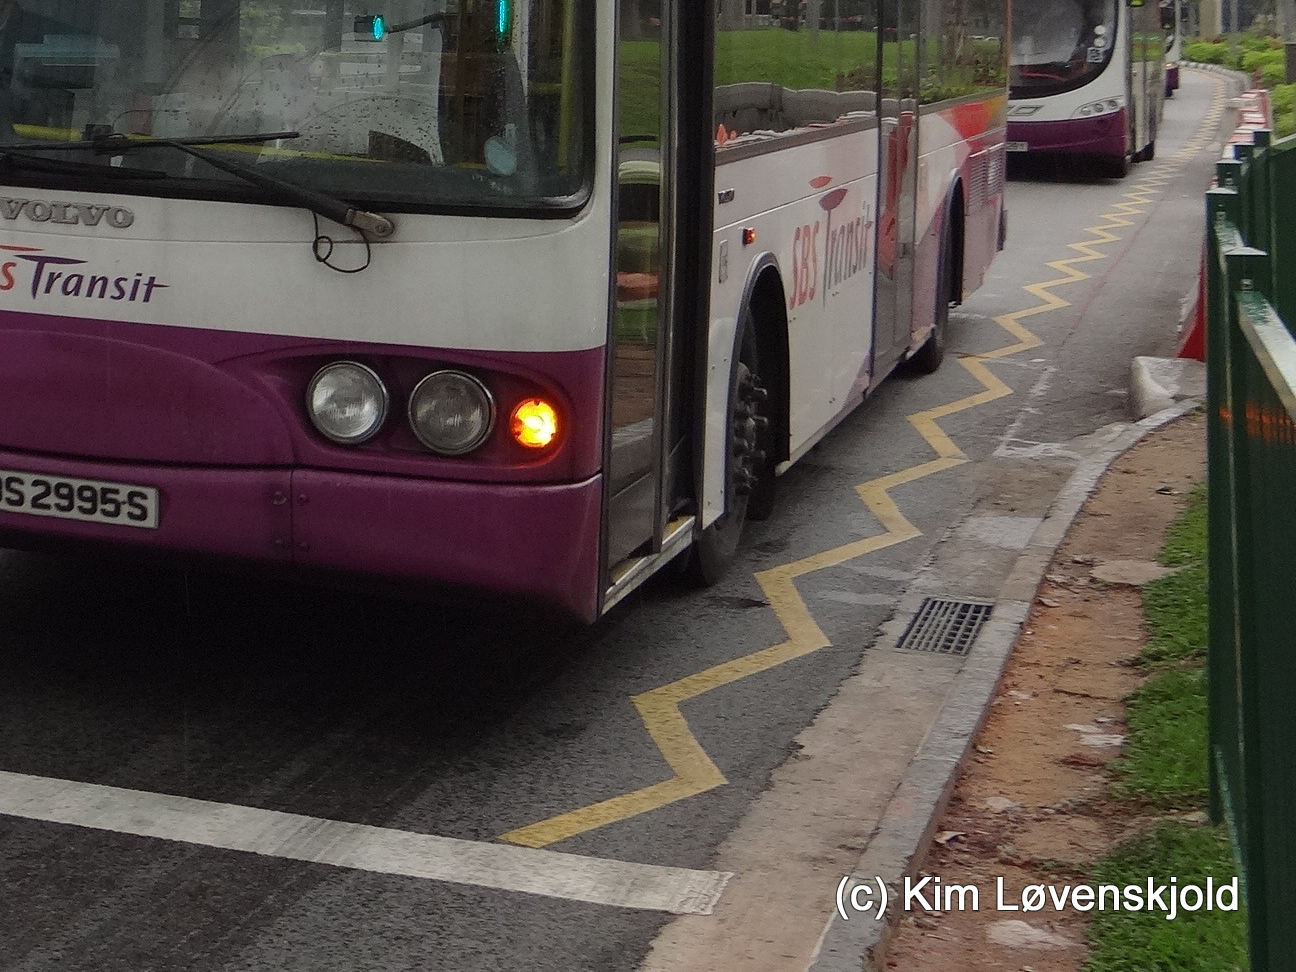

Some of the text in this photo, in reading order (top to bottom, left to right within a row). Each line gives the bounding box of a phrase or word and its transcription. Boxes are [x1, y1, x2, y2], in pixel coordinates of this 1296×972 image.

[13, 254, 171, 303] Transit
[790, 221, 820, 311] SBS
[819, 189, 874, 310] Transit
